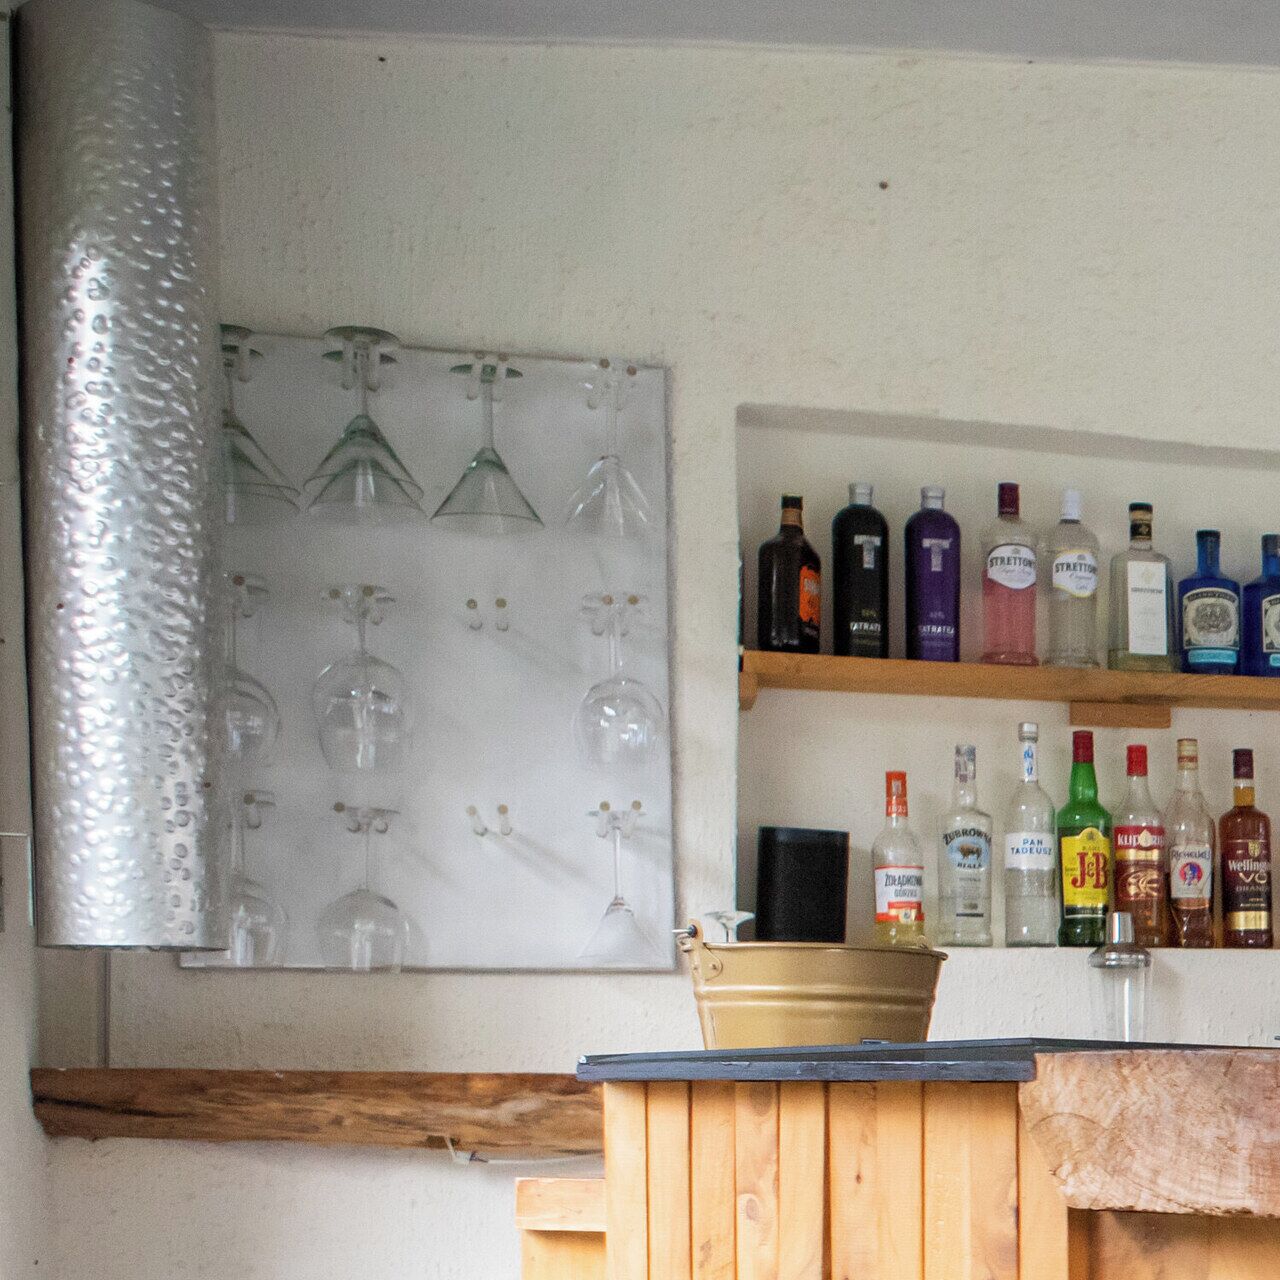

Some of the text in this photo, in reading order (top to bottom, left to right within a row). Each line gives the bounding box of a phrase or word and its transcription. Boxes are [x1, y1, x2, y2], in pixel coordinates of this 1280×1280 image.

[854, 535, 882, 569] T
[1011, 847, 1052, 856] TADEUSZ
[1071, 852, 1108, 889] J&B
